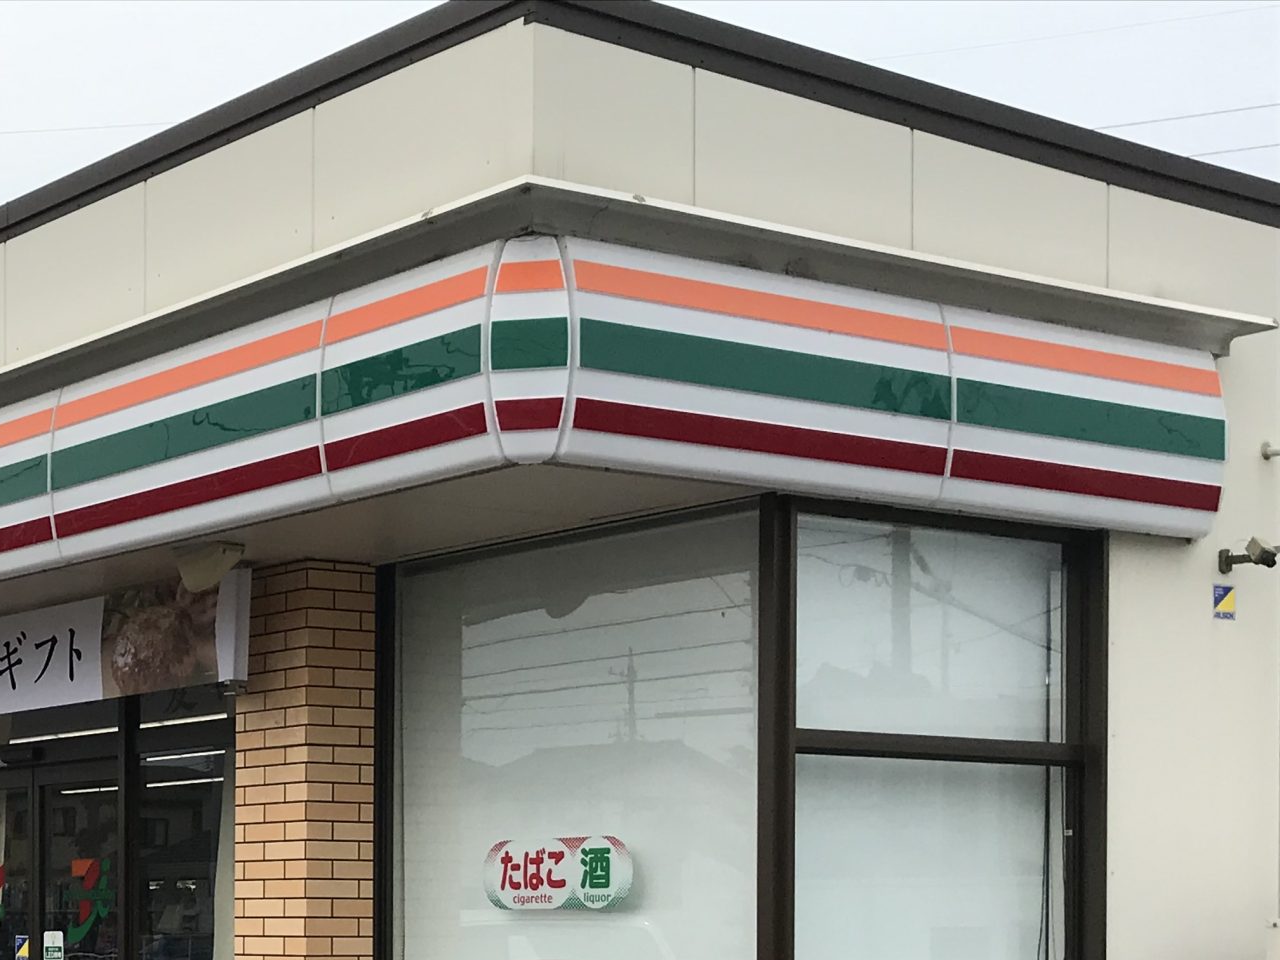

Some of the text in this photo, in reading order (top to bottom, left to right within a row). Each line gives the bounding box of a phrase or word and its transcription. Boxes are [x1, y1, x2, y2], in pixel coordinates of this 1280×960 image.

[500, 848, 567, 891] たばこ
[580, 847, 611, 889] 酒
[512, 893, 553, 906] cigarette
[583, 891, 612, 903] liquor
